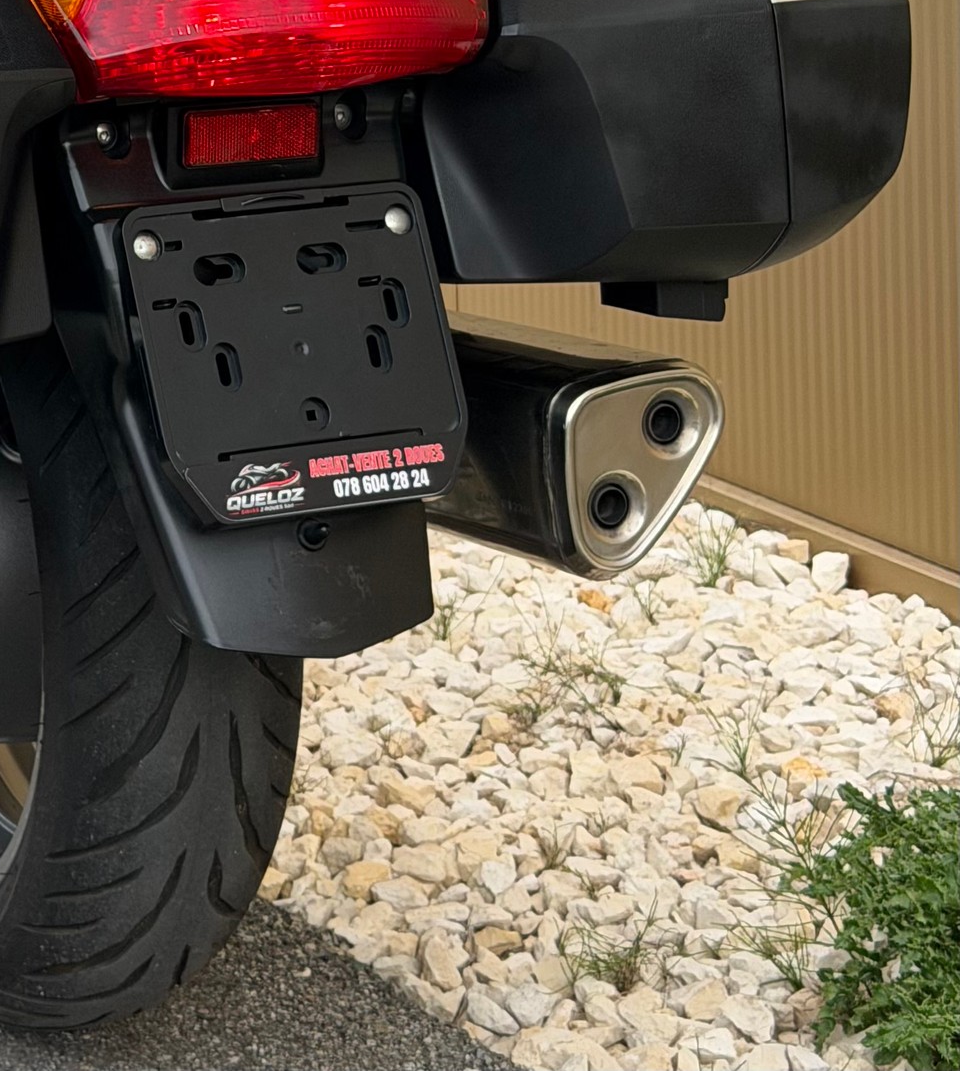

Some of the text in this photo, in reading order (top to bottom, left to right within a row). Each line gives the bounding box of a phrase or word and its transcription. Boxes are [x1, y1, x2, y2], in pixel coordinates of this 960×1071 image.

[308, 443, 445, 478] ACHAT-VENTE 2 ROUES
[333, 467, 430, 498] 078 604 28 24
[226, 487, 305, 511] QUELOZ
